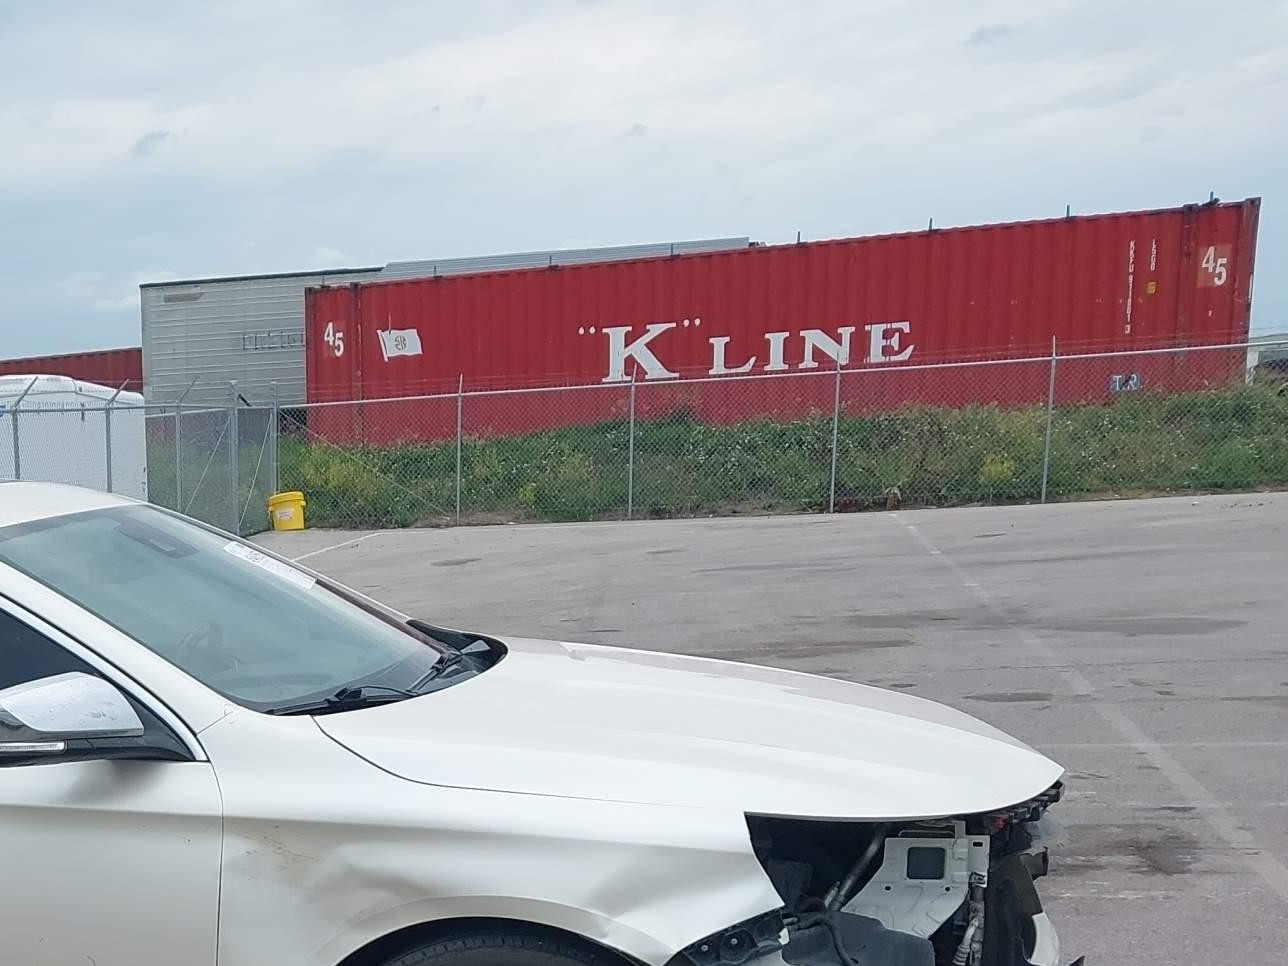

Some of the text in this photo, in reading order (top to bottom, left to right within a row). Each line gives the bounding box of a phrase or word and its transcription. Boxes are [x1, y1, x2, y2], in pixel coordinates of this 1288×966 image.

[1201, 246, 1228, 286] 45
[324, 321, 345, 357] 45
[708, 321, 915, 376] LINE
